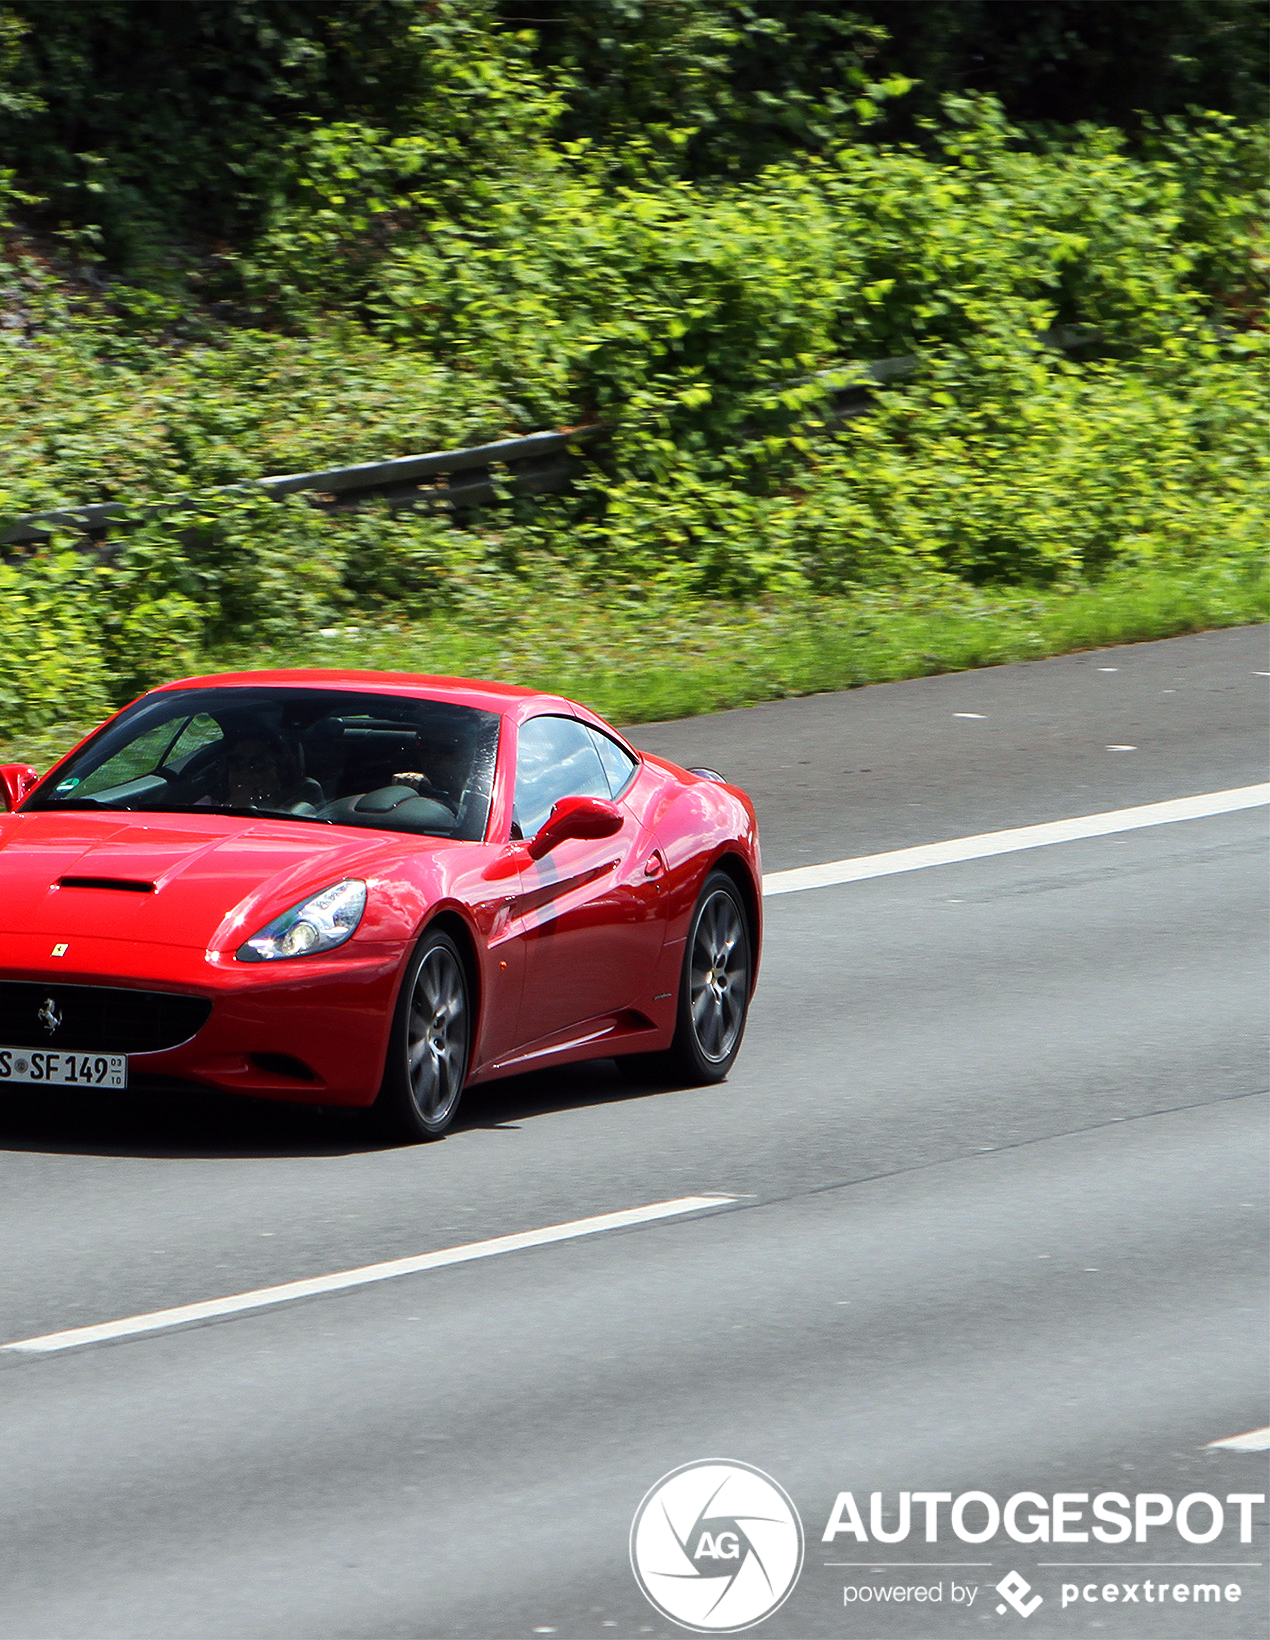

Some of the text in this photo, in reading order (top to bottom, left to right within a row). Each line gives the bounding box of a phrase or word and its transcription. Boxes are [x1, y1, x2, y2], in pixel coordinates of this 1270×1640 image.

[111, 1058, 122, 1067] 03
[30, 1053, 60, 1080] SF
[65, 1056, 108, 1083] 149
[111, 1077, 122, 1085] 10
